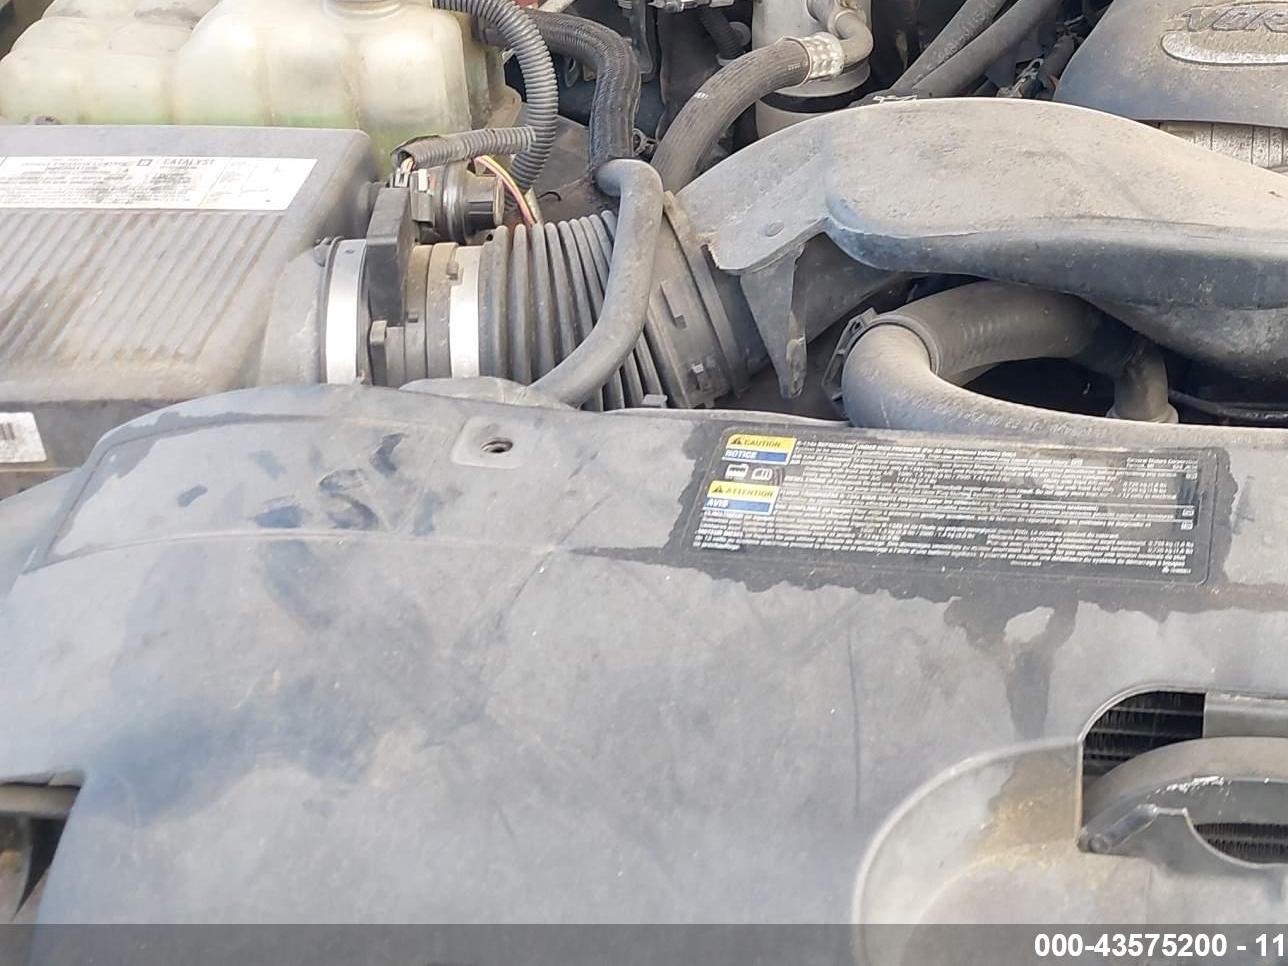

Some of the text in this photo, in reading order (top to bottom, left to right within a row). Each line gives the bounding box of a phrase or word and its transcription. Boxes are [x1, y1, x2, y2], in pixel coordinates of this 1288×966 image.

[743, 438, 781, 448] CAUTION
[725, 449, 758, 459] NOTICE
[725, 486, 773, 498] ATTENTION
[706, 498, 730, 508] AVIS
